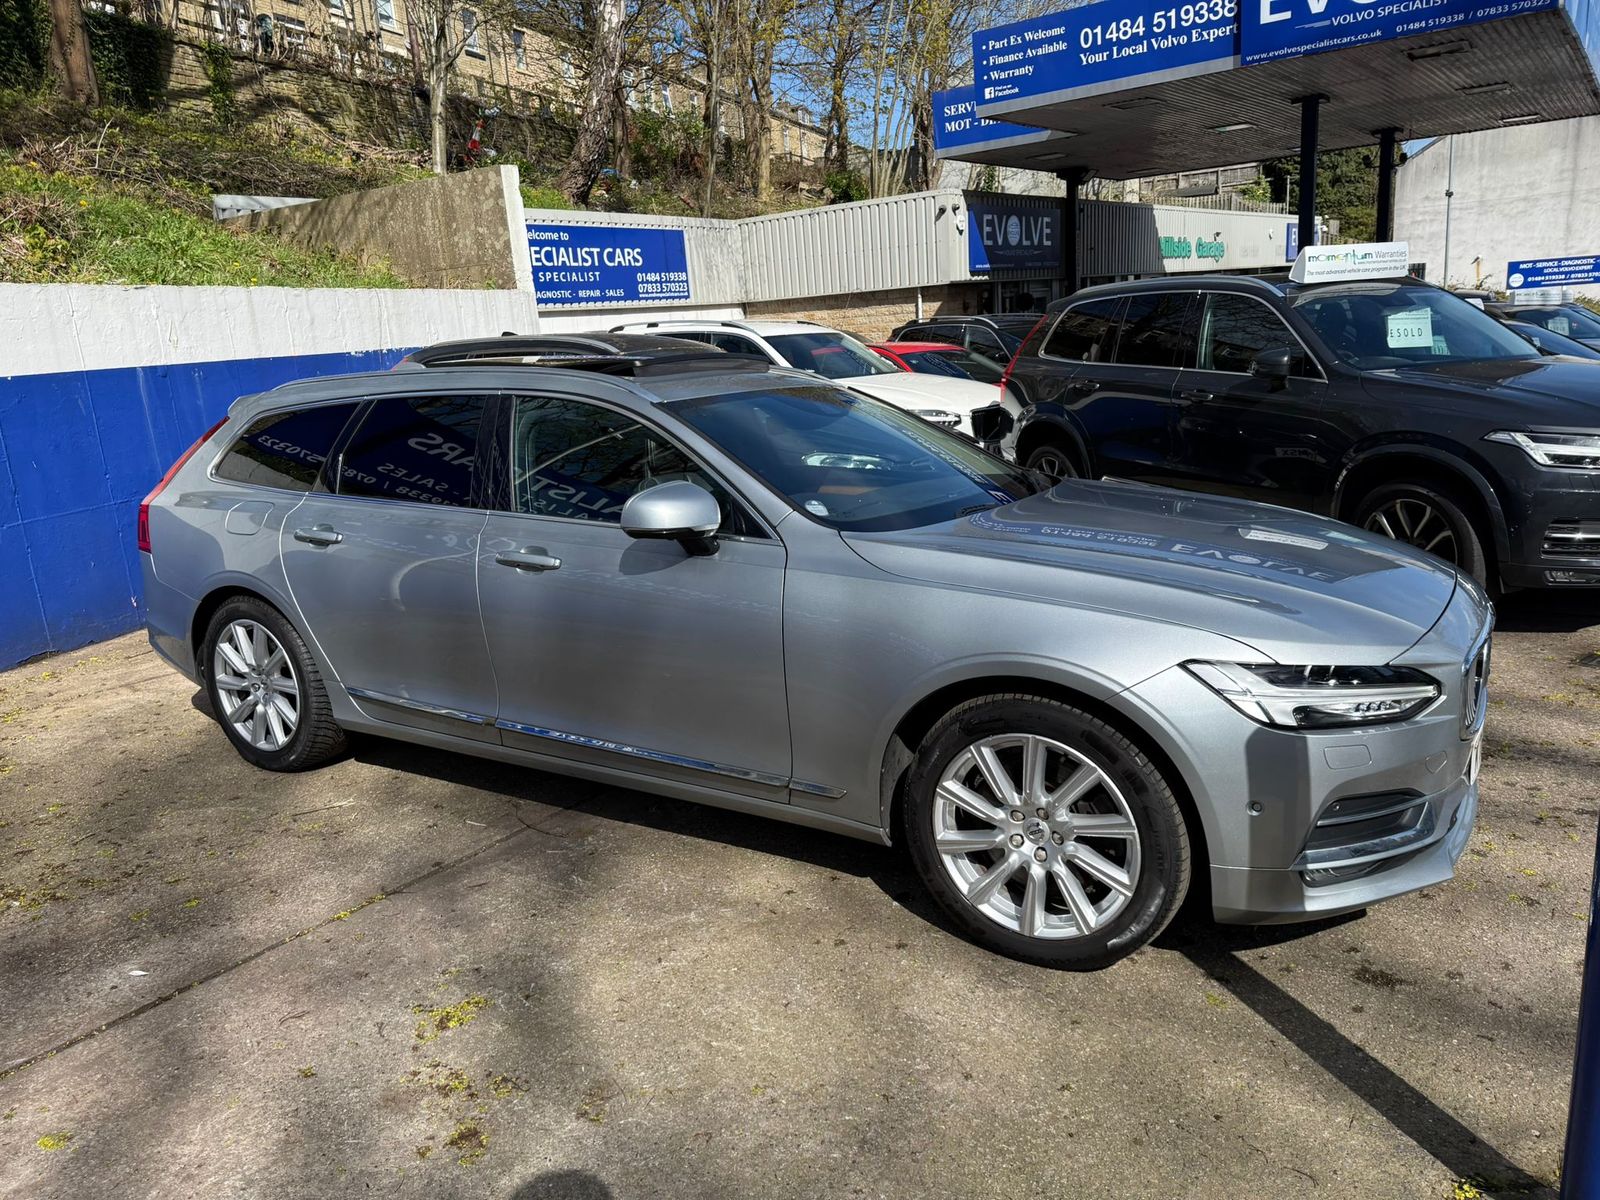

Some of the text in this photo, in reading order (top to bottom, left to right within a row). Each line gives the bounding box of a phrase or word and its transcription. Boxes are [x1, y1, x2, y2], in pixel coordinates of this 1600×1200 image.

[1332, 0, 1450, 27] VOLVO SPECIALIST
[1396, 20, 1426, 33] 01484
[1427, 13, 1465, 27] 519338
[1477, 5, 1509, 17] 07833
[1079, 0, 1239, 49] 01484 519338
[988, 26, 1066, 51] Part Ex Welcome
[1079, 22, 1239, 66] Your Local Volvo Expert
[1246, 29, 1382, 62] www.evolvespecialistcars.co.uk
[989, 40, 1068, 67] Finance Available
[990, 64, 1035, 81] Warranty
[995, 87, 1020, 98] Facebook
[944, 118, 972, 133] MOT
[560, 231, 570, 240] to
[530, 246, 643, 267] ECIALIST CARS
[1158, 236, 1225, 263] Hillside Garage
[1375, 249, 1408, 259] Warranties
[538, 271, 600, 282] SPECIALIST
[637, 271, 687, 283] 01484 519338
[1326, 268, 1347, 276] advanced
[536, 290, 572, 299] AGNOSTIC
[578, 289, 601, 298] REPAIR
[605, 288, 625, 297] SALES
[638, 282, 688, 293] 07833 570323
